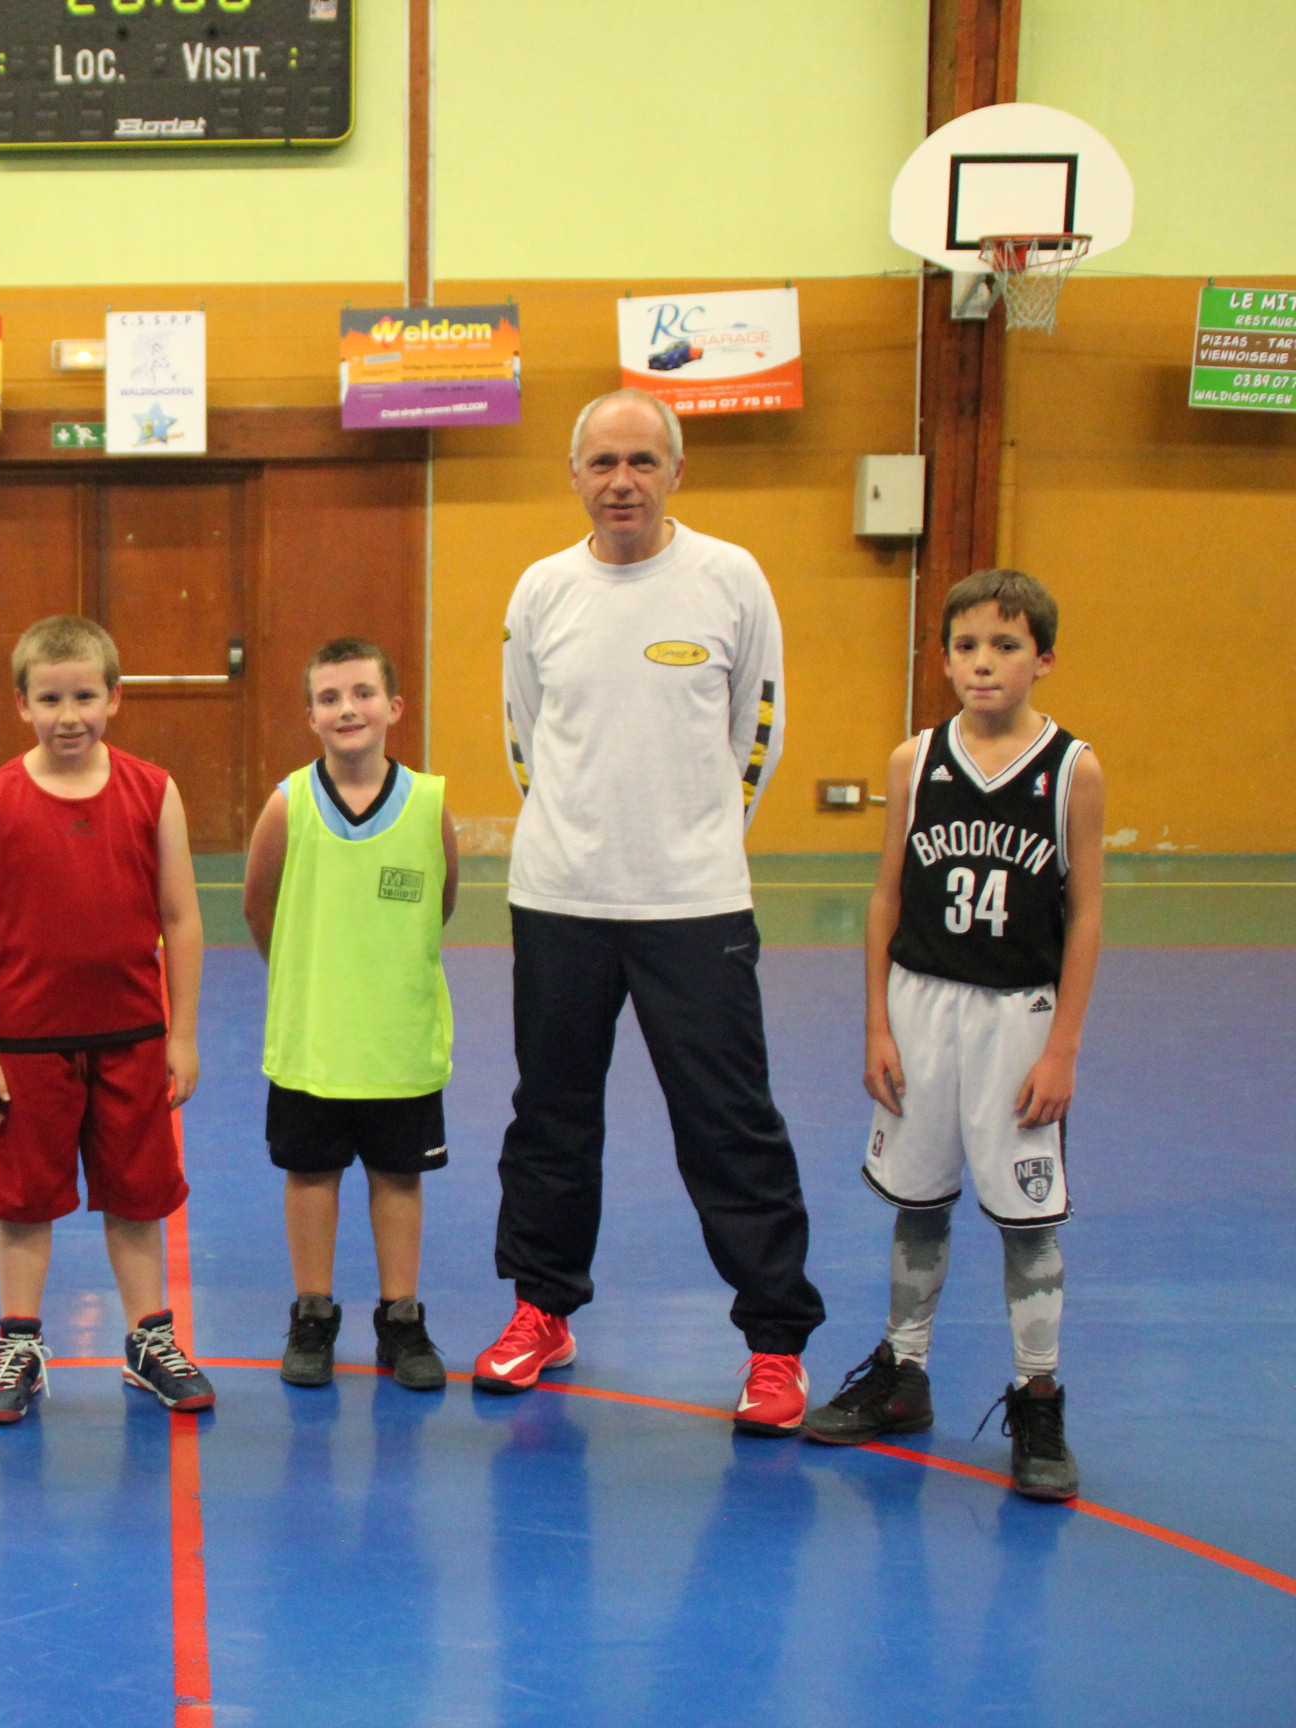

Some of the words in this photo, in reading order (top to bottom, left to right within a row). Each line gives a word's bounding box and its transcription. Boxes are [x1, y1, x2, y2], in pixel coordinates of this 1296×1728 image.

[1229, 292, 1255, 309] LE
[371, 318, 492, 343] Weldom
[647, 303, 707, 345] RC
[693, 331, 771, 346] GARAGE
[1201, 334, 1248, 347] PIZZAS
[1200, 349, 1290, 363] VIENNOISERIE
[1233, 373, 1252, 386] 03
[1253, 374, 1271, 387] 89
[1272, 376, 1290, 388] 07
[1194, 389, 1293, 404] WALDIGHOFFEN
[911, 820, 1056, 875] BROOKLYN
[944, 867, 1009, 937] 34
[1017, 1159, 1054, 1180] NETS
